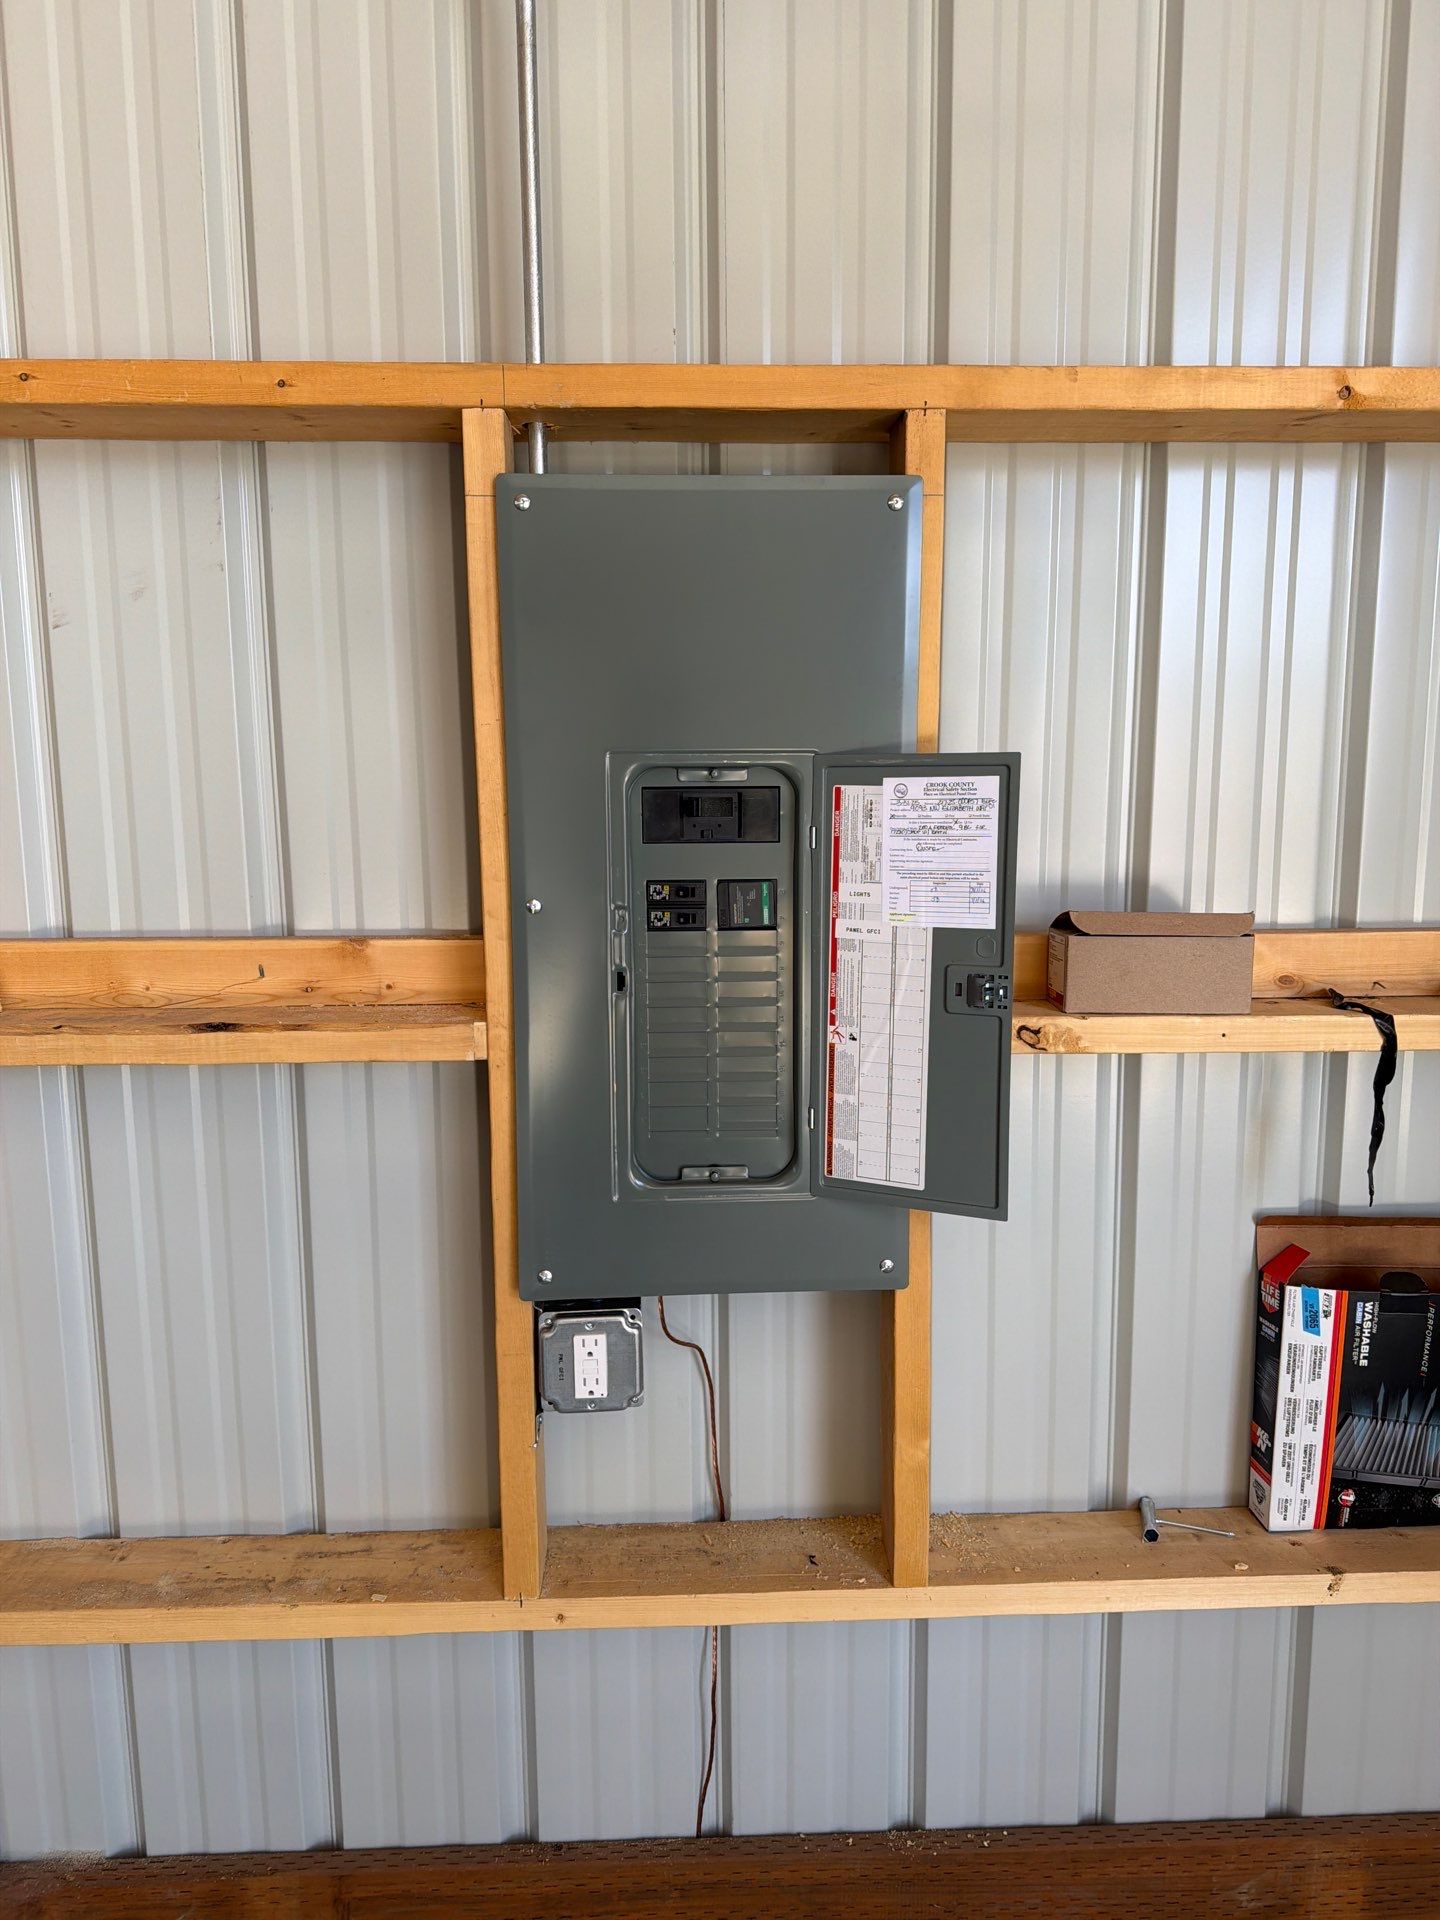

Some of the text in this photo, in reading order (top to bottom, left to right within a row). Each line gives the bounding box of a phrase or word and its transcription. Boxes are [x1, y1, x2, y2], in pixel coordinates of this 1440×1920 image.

[1261, 1281, 1280, 1299] LIFE
[1261, 1291, 1280, 1309] TIME
[1355, 1302, 1363, 1324] CABIN
[1359, 1301, 1373, 1366] WASHABLE
[1420, 1307, 1435, 1372] PERFORMANCE
[1257, 1426, 1272, 1453] K&N
